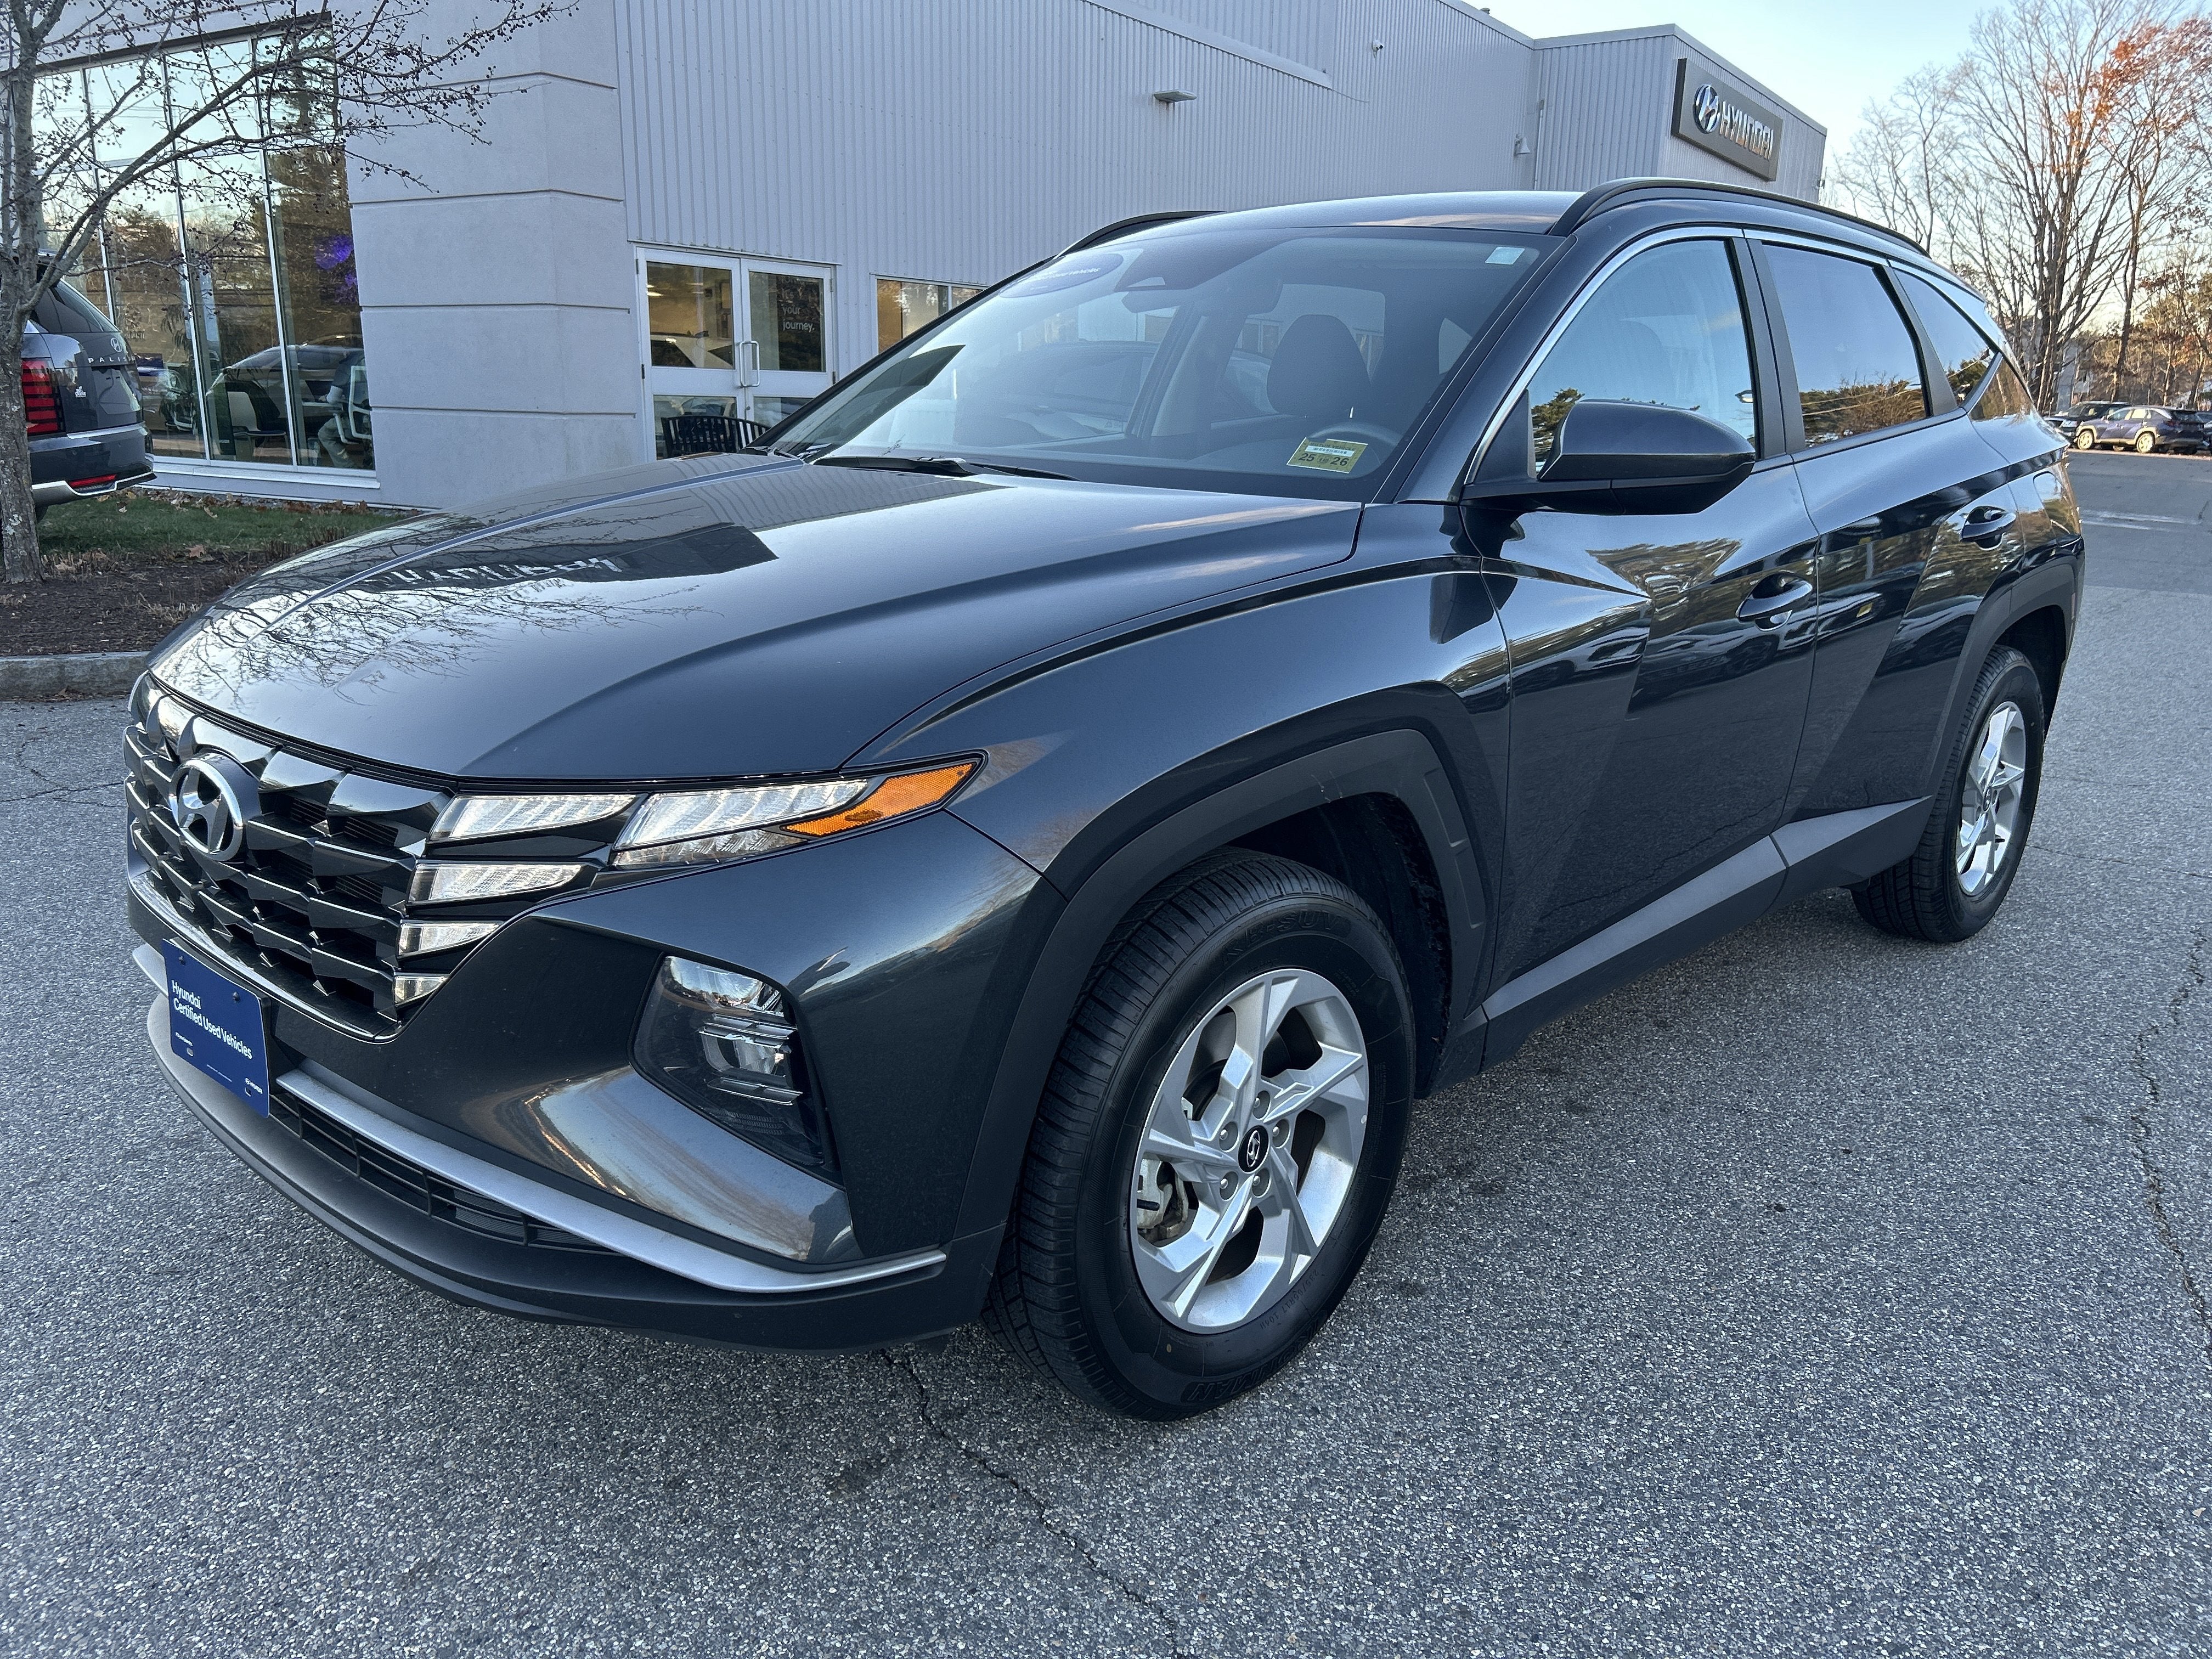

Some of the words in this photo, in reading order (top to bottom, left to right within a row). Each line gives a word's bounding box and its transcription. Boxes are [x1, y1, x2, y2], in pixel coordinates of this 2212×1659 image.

[1719, 100, 1774, 160] HYUNDAI
[782, 306, 800, 315] your
[783, 318, 815, 332] journey.
[1299, 453, 1316, 462] 25
[1330, 457, 1349, 466] 26
[172, 980, 201, 1009] Hyundai
[174, 997, 202, 1026] Certified
[203, 1016, 221, 1039] Used
[221, 1028, 252, 1059] Vehicles
